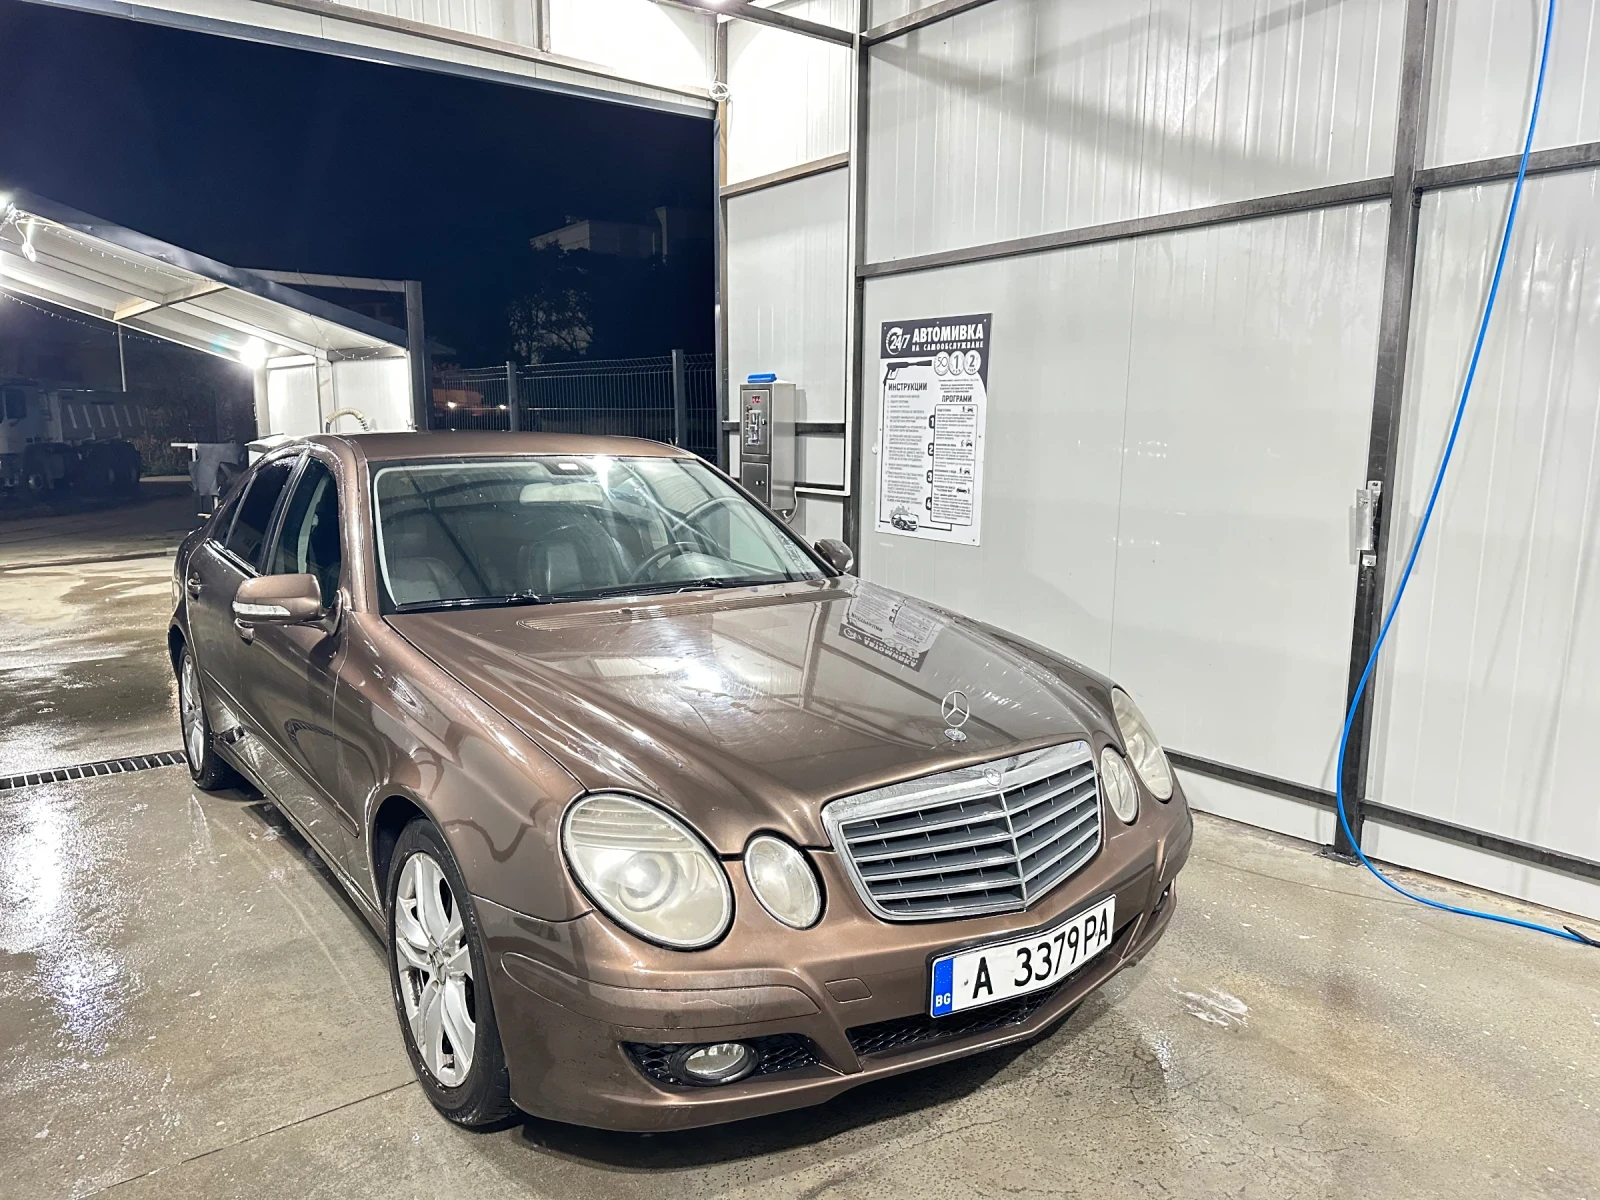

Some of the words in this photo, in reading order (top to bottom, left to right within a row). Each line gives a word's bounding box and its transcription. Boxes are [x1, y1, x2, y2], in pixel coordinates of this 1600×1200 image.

[889, 329, 911, 351] 24/7
[912, 324, 983, 343] АВТОМИВКА
[911, 344, 920, 352] НА
[923, 341, 984, 351] САМООБСЛУЖВАНЕ
[937, 356, 948, 368] 50
[888, 382, 928, 391] ИНСТРУКЦИИ
[941, 395, 972, 403] ПРОГРАМИ
[935, 993, 951, 1008] BG
